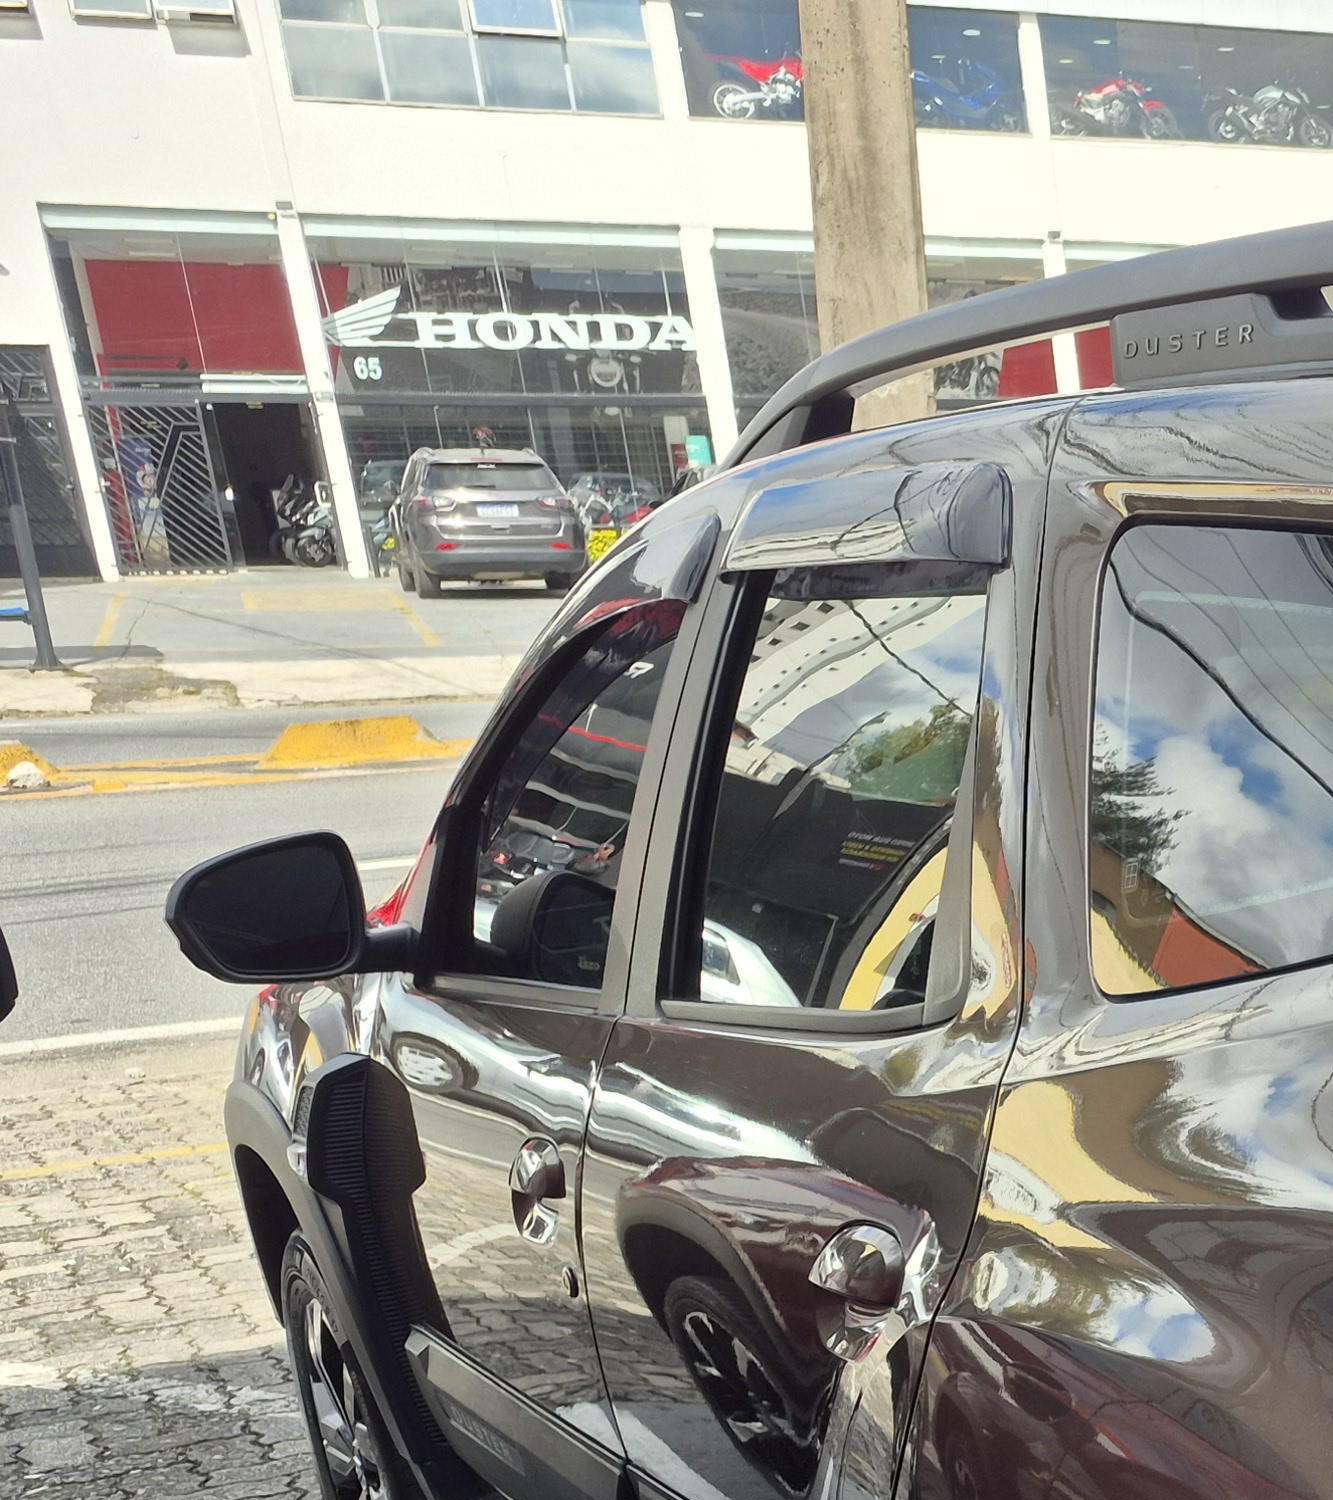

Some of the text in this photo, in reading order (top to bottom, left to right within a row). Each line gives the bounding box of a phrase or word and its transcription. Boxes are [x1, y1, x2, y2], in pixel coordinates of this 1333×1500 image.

[410, 312, 697, 351] HONDA
[1124, 324, 1254, 359] DUSTER
[353, 356, 382, 380] 65
